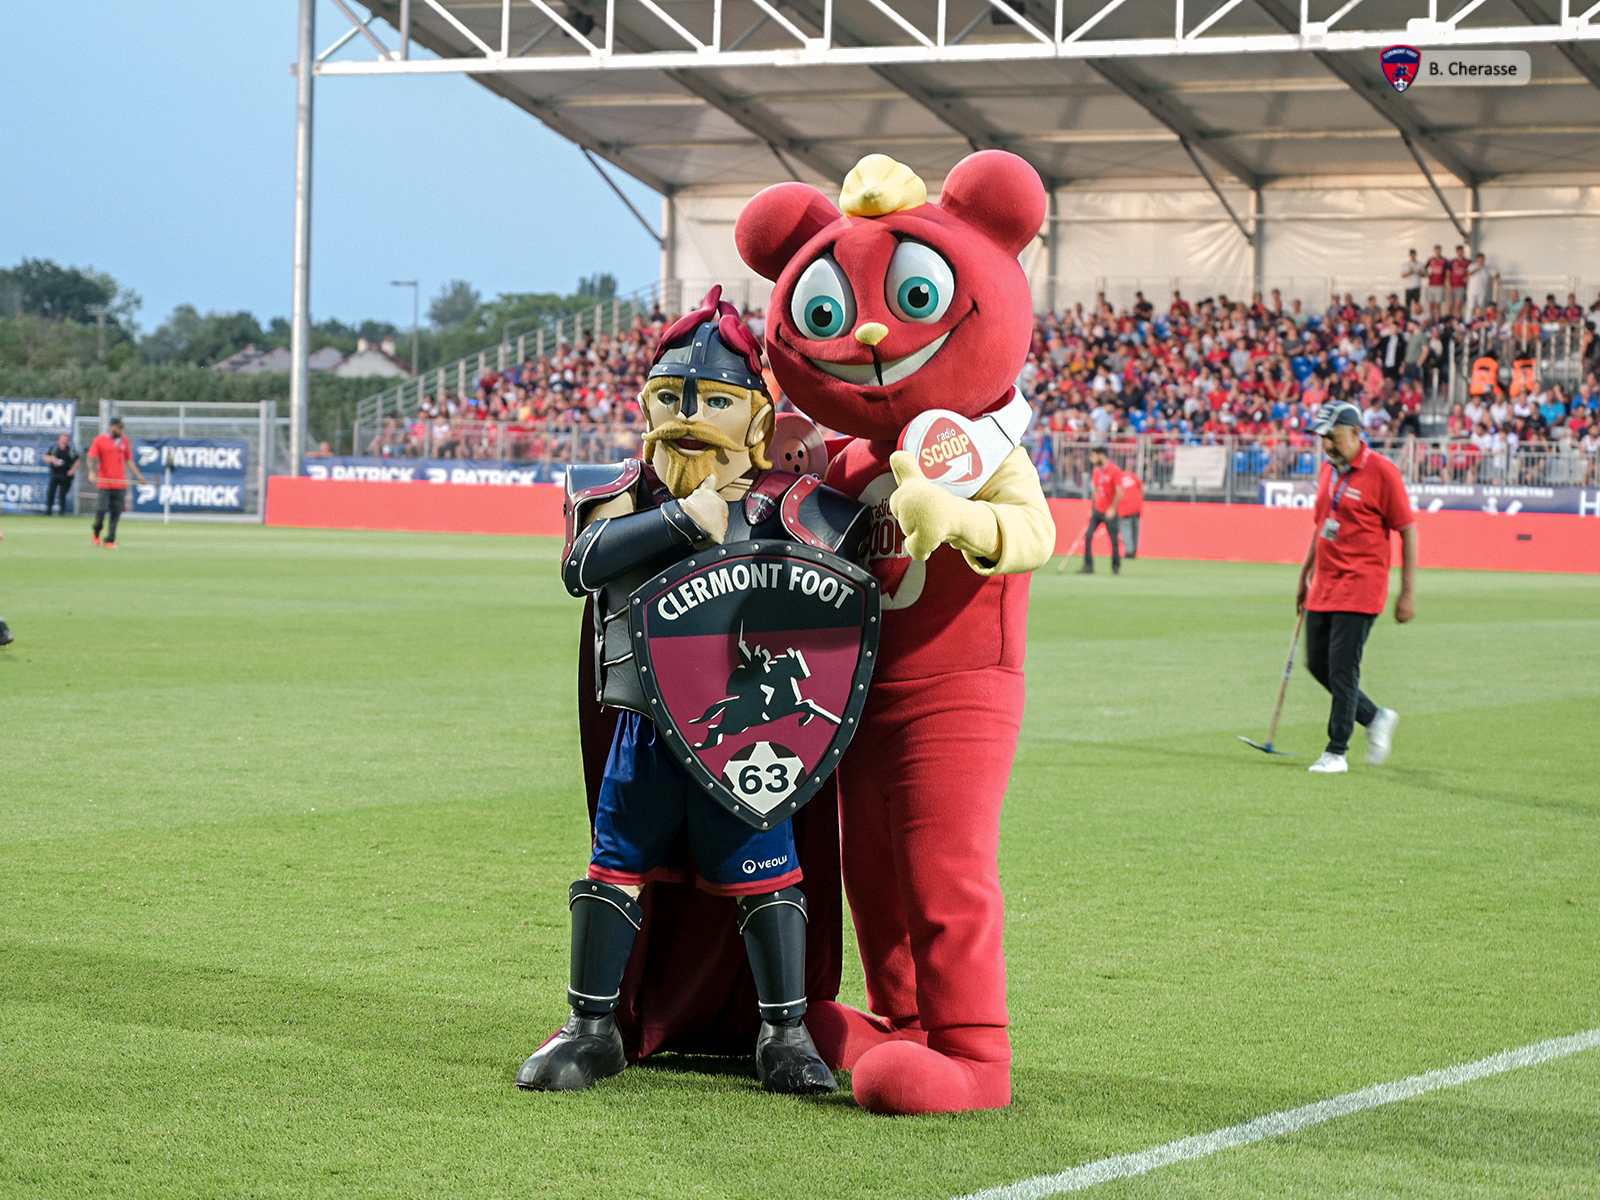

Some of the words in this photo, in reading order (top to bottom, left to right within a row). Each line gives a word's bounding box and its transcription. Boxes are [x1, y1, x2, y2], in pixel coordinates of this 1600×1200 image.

[936, 428, 957, 443] radio
[921, 433, 970, 468] SCOOP
[332, 465, 415, 483] PATRICK
[451, 468, 537, 486] PATRICK
[159, 485, 240, 507] PATRICK
[657, 563, 782, 621] CLERMONT
[788, 566, 854, 609] FOOT
[738, 763, 789, 795] 63
